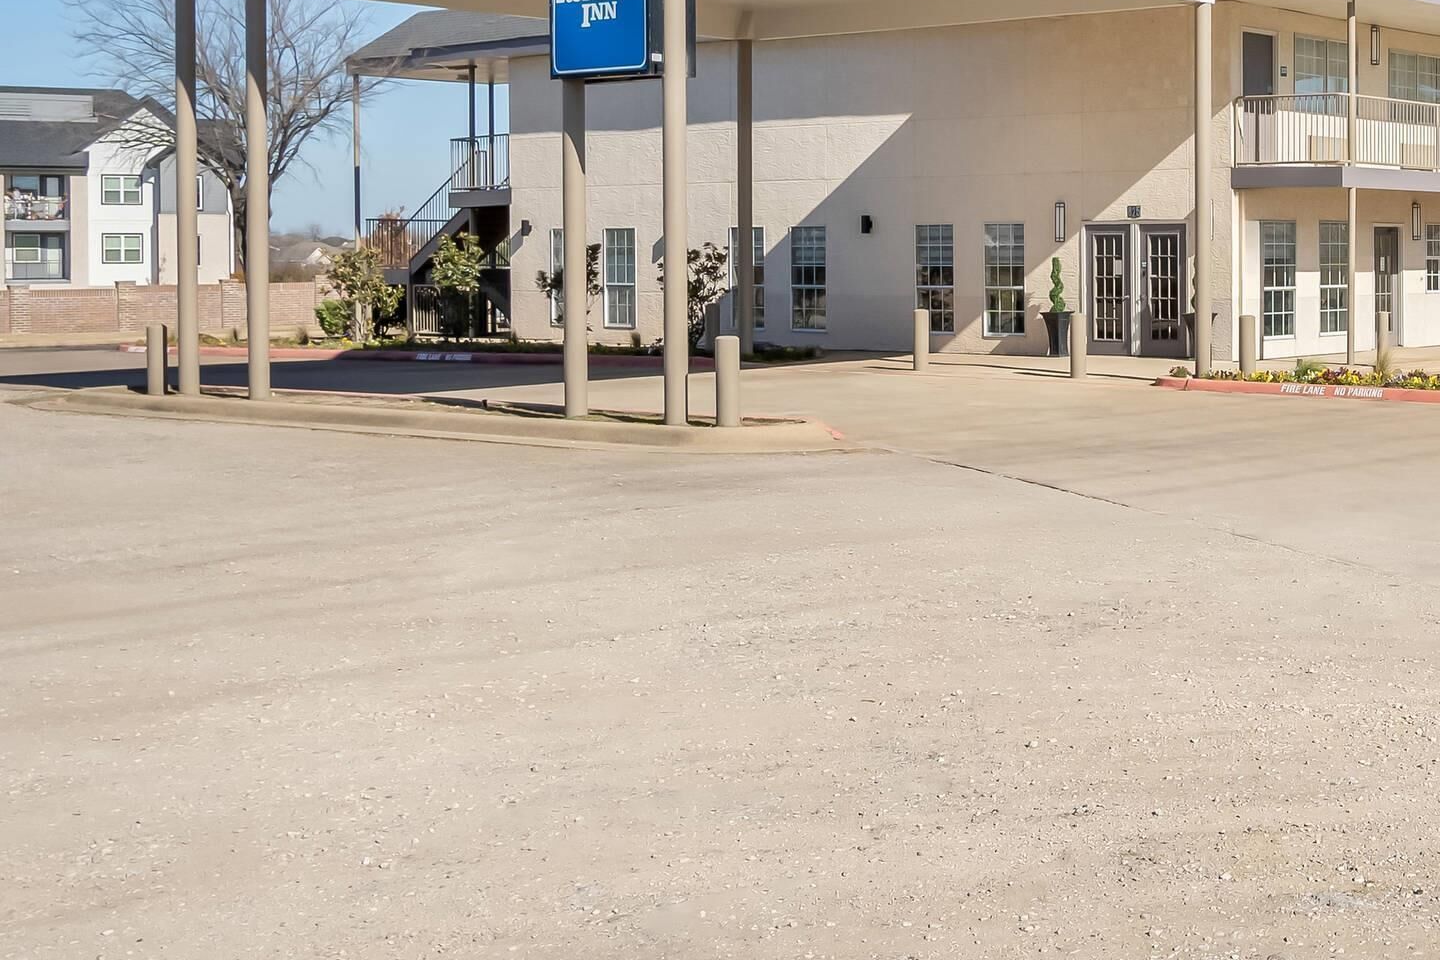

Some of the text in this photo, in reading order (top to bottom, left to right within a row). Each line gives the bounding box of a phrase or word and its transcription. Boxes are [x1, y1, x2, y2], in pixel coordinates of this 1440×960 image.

[581, 1, 617, 27] INN
[1281, 384, 1383, 398] FIRE LANE NO PARKING
